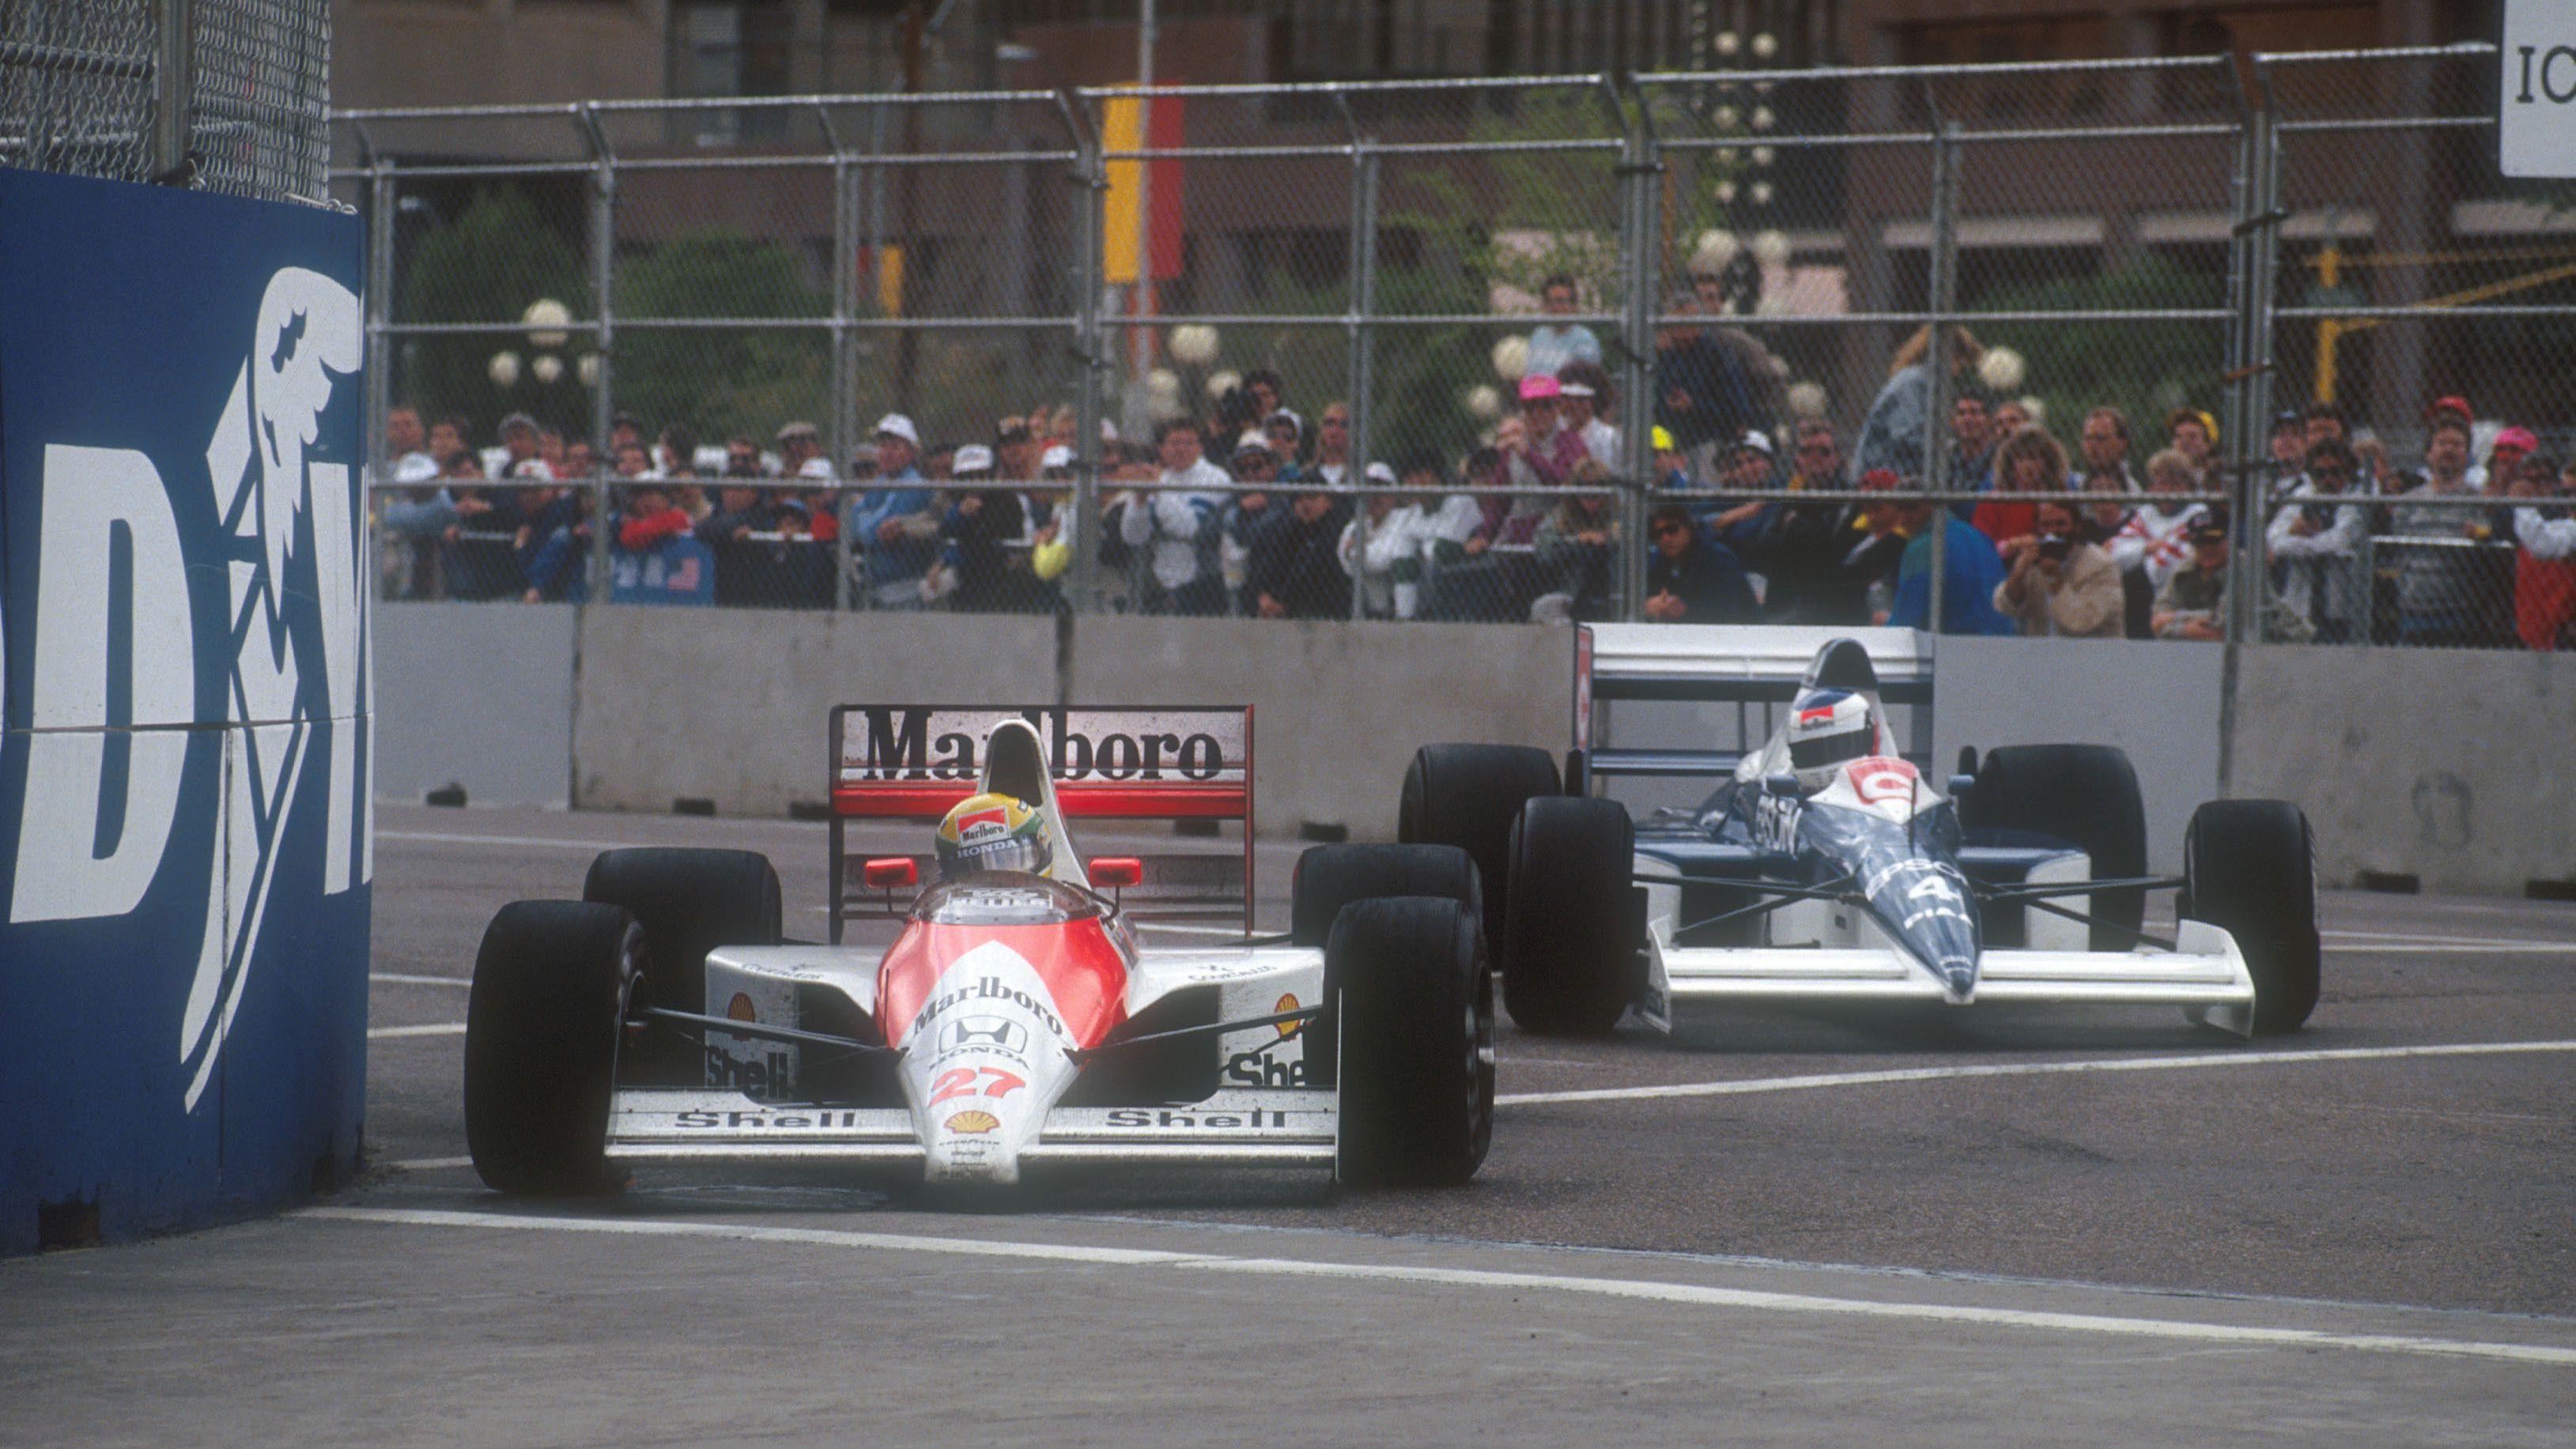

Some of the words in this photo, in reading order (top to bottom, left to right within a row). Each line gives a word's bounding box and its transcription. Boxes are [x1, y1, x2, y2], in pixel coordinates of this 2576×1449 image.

[862, 710, 1223, 781] Maboro
[962, 823, 1004, 841] Marlboro
[958, 838, 1019, 858] HONDA
[1908, 875, 1963, 901] 4
[914, 975, 1063, 1036] Marlboro
[928, 1047, 1033, 1072] HONDA
[1229, 1052, 1306, 1086] She
[927, 1066, 1026, 1109] 27
[675, 1112, 856, 1128] Shell
[1105, 1110, 1285, 1128] Shell
